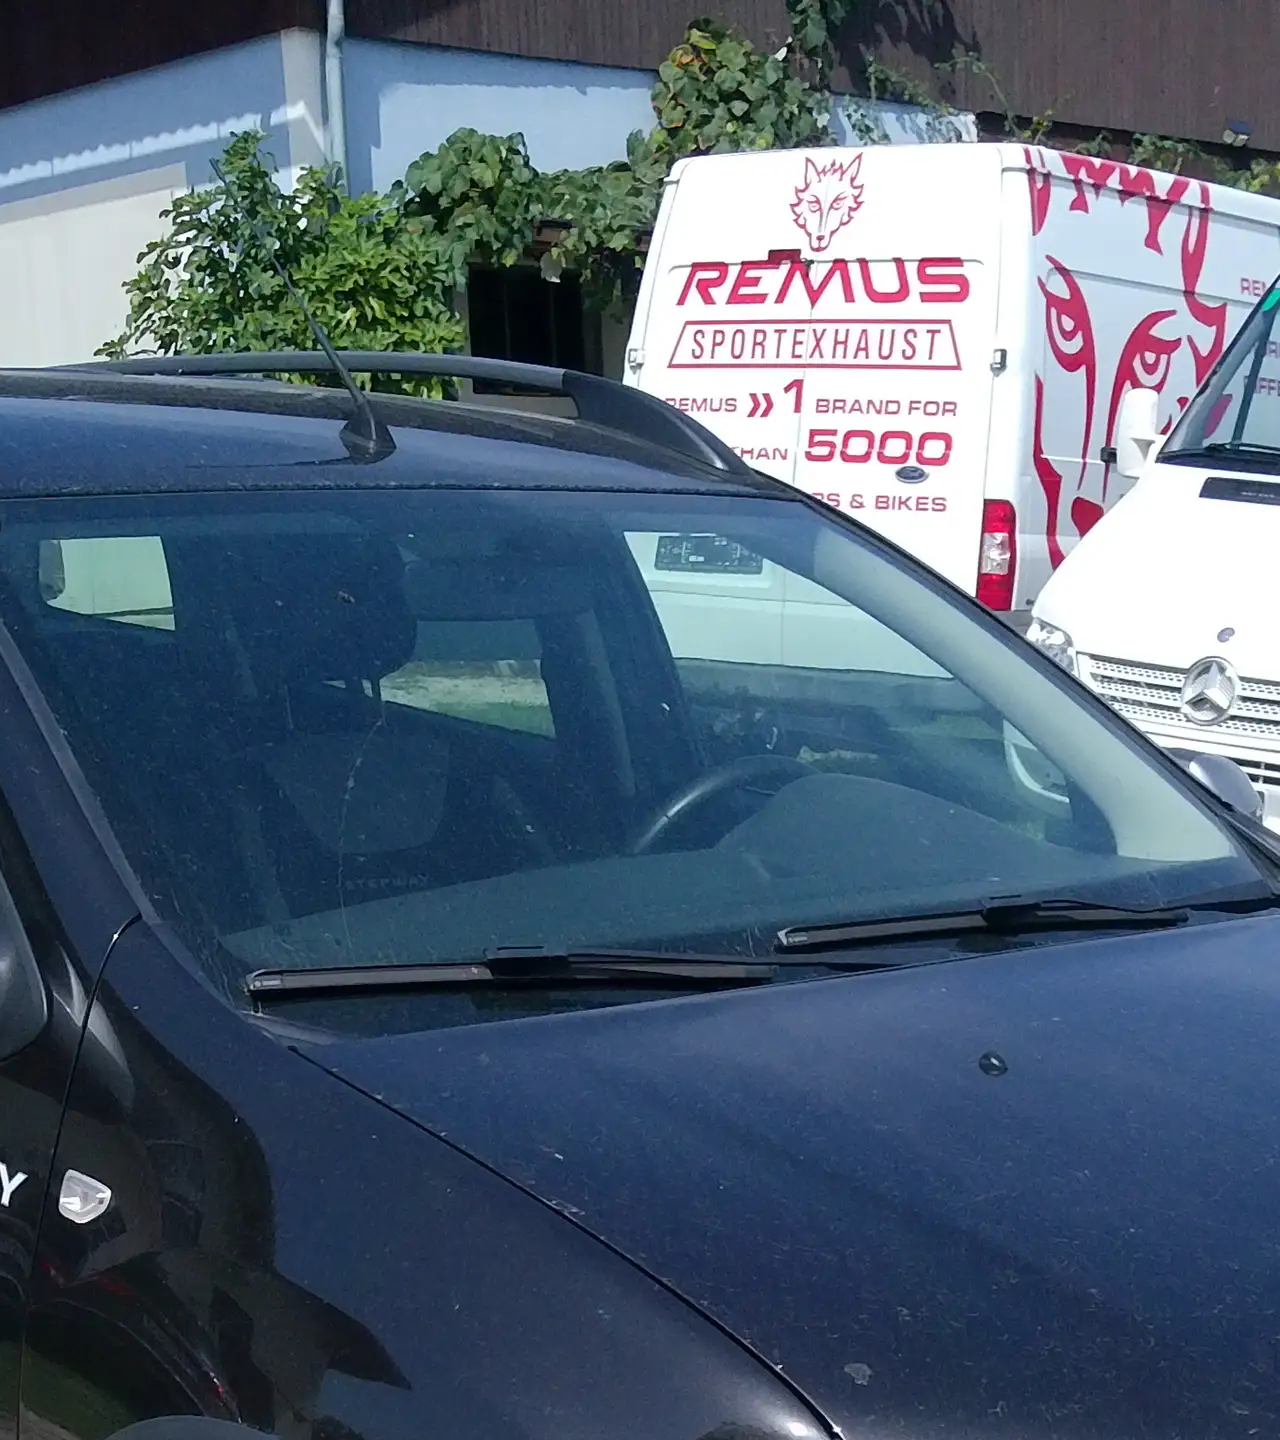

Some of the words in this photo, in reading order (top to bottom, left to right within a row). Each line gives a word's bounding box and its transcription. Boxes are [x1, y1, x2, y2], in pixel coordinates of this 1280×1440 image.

[676, 257, 970, 308] REMUS
[691, 329, 942, 360] SPORTEXHAUST
[783, 379, 805, 414] 1
[815, 399, 902, 416] BRAND
[908, 400, 959, 417] FOR
[729, 446, 788, 461] HAN
[804, 429, 953, 467] 5000
[849, 494, 866, 509] &
[875, 496, 948, 512] BIKES
